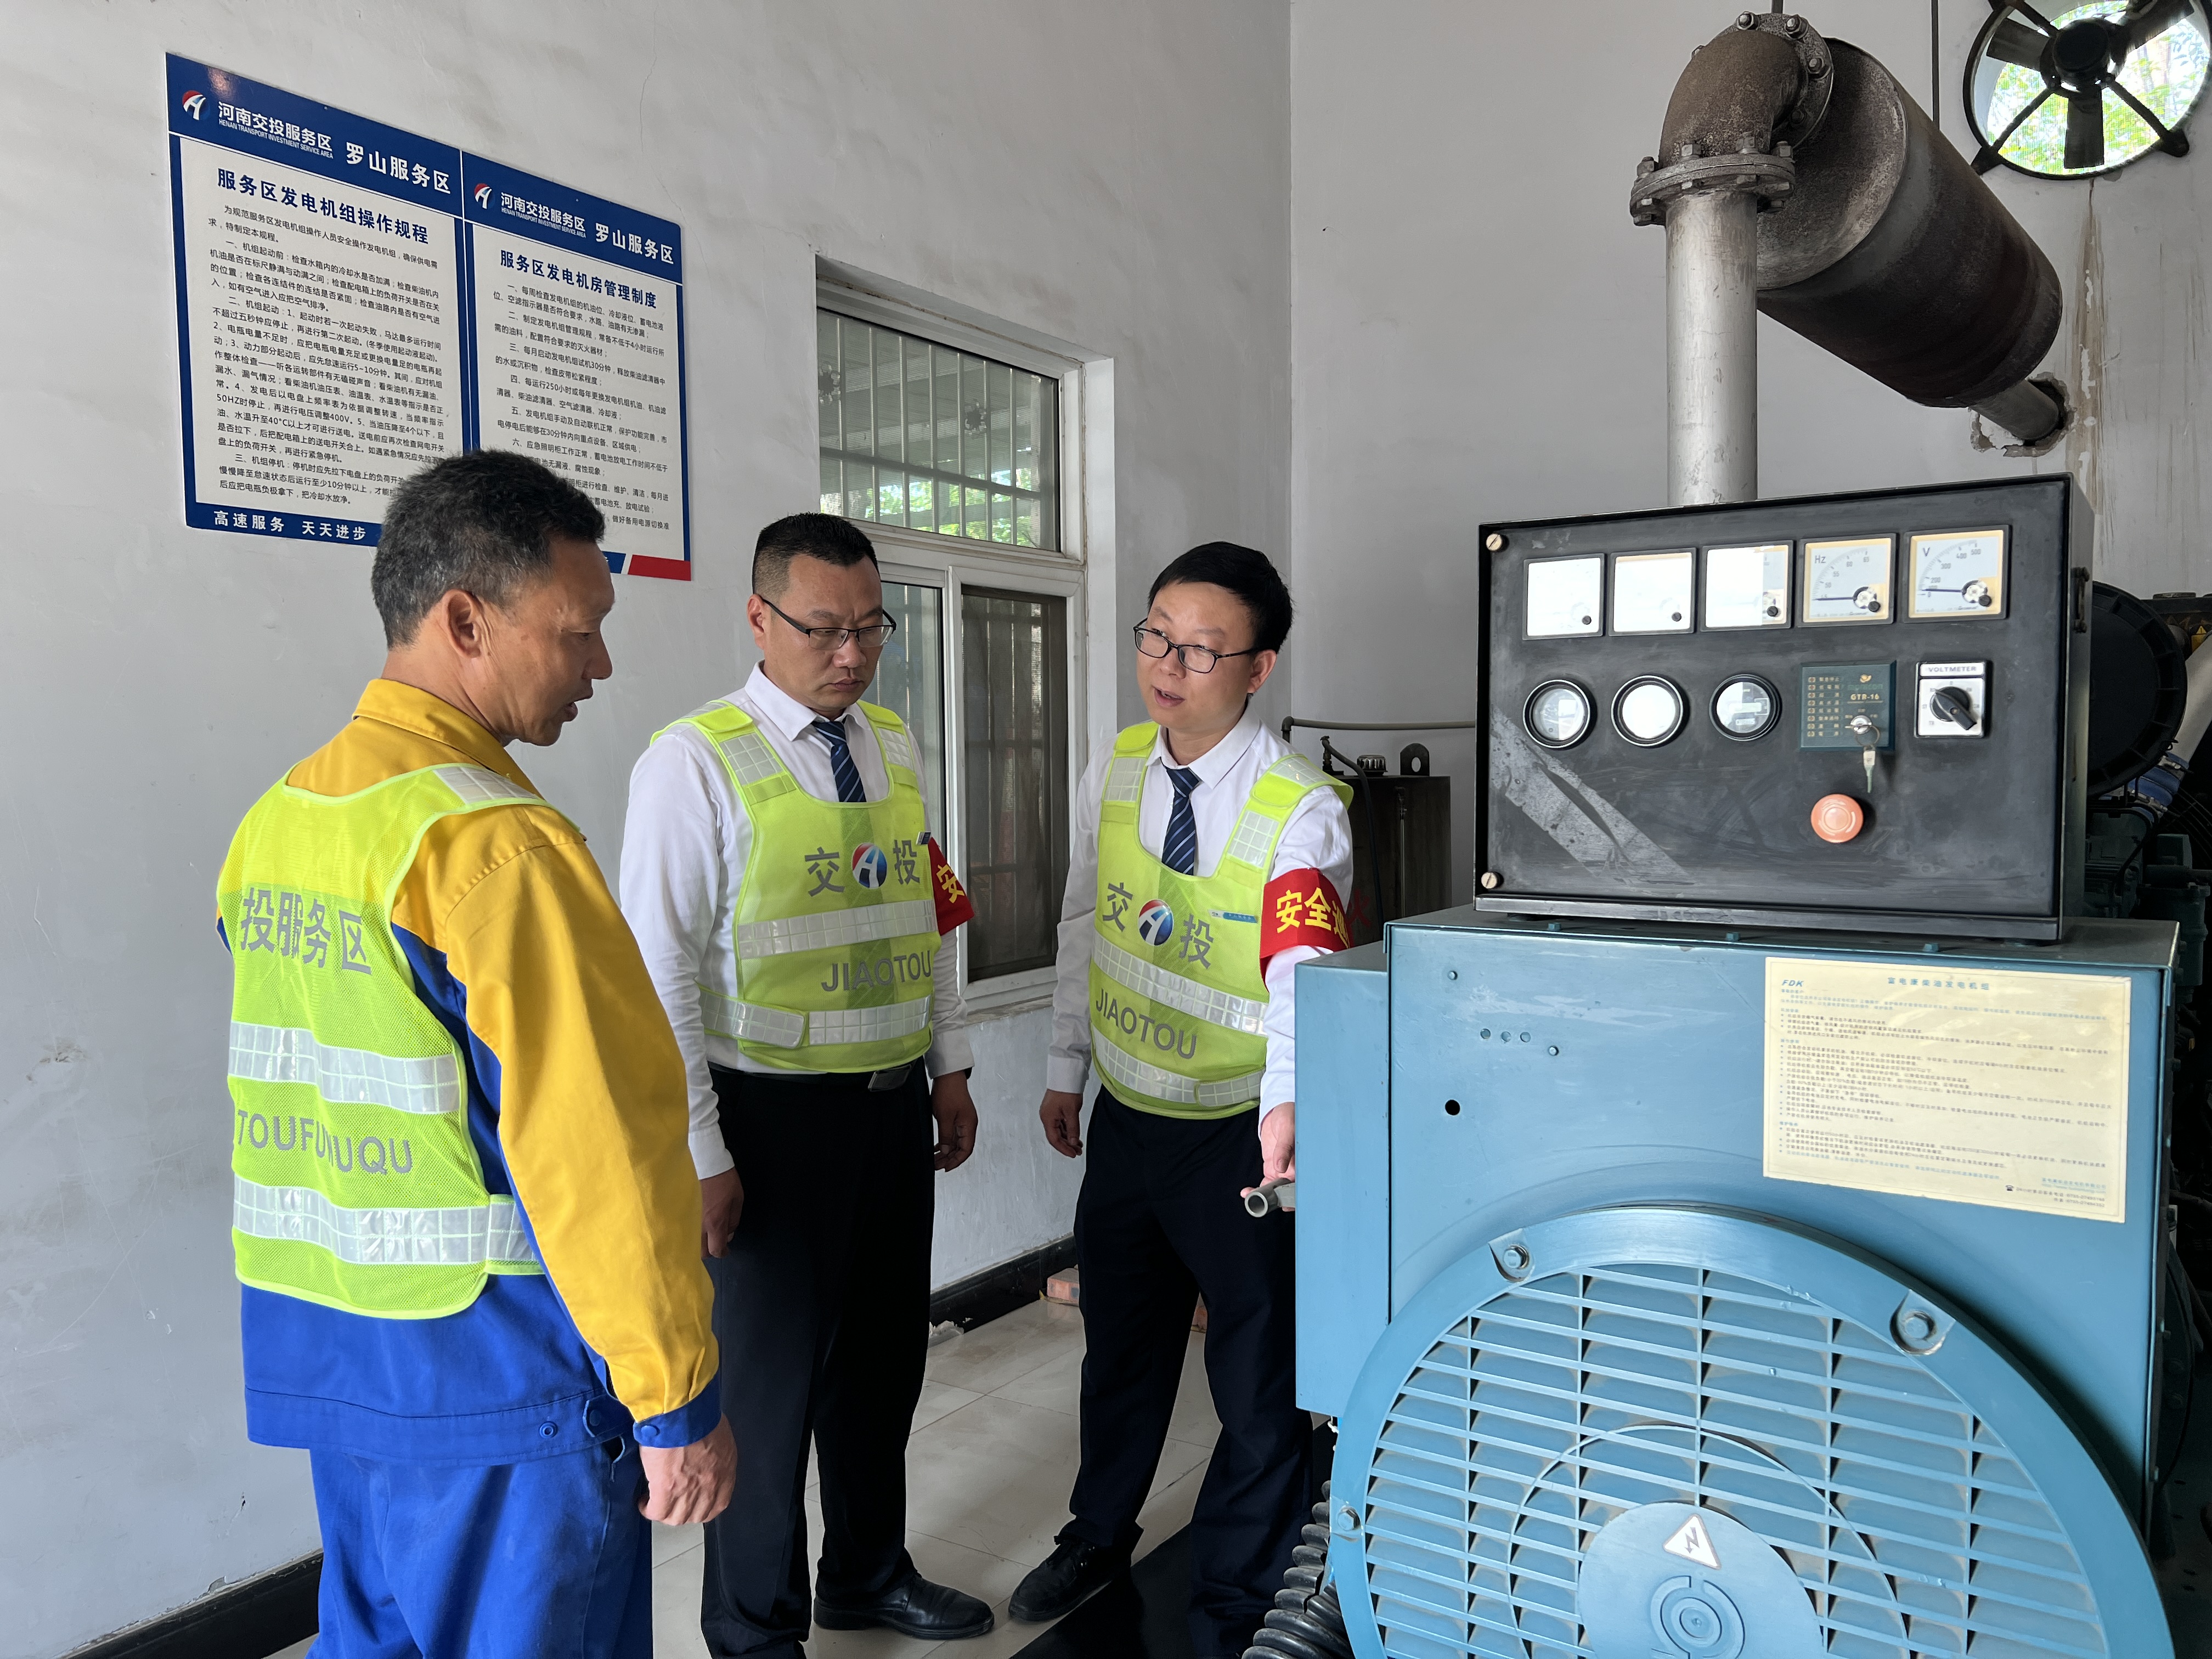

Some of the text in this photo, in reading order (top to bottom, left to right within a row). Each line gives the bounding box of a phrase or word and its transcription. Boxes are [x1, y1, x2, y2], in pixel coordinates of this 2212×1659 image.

[218, 117, 333, 159] HENAN TRANSPORT INVESTMENT SERVICE AREA
[218, 100, 450, 195] 河南交投服务区 罗山服务区
[217, 166, 428, 245] 服务区发电机组操作规程
[500, 191, 673, 265] 河南交投服务区 罗山服务区
[500, 248, 656, 309] 服务区发电机房管理制度
[213, 509, 366, 541] 高速服务 天天进步
[1923, 547, 1930, 557] V
[1815, 555, 1826, 564] Hz
[804, 839, 921, 897] 交 投
[936, 863, 965, 904] 安
[240, 887, 373, 975] 投服务区
[1102, 882, 1215, 969] 交 投
[821, 950, 933, 992] JIAOTOU
[1096, 987, 1198, 1060] JIAOTOU
